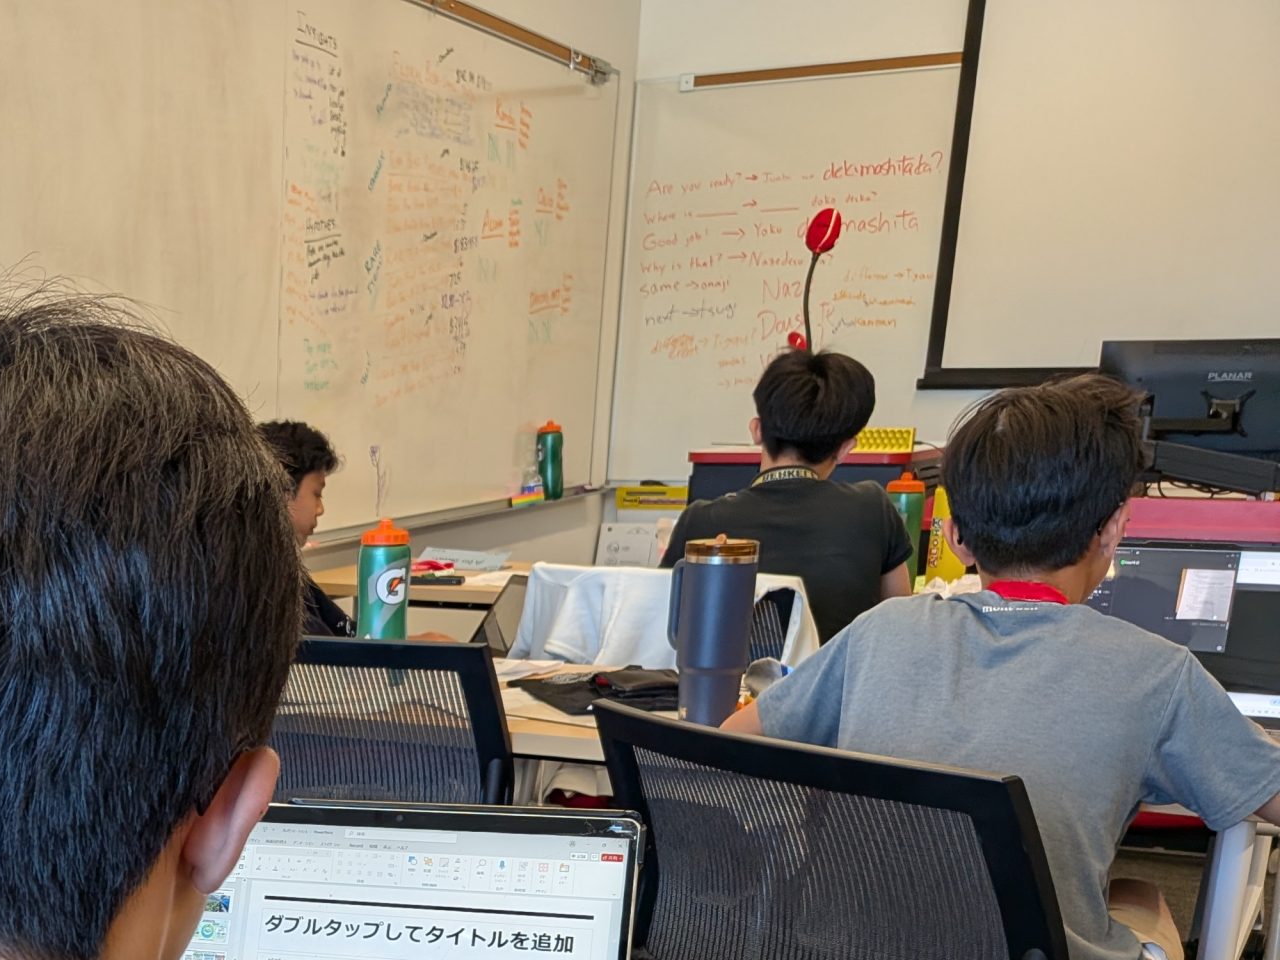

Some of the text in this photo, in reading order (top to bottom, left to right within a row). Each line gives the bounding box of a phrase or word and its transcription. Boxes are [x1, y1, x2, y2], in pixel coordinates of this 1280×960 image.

[642, 233, 678, 250] Good
[640, 261, 665, 274] Why
[640, 281, 680, 297] same
[1208, 371, 1253, 382] PLANAR
[264, 914, 575, 953] ダブルタップしてタイトルを追加
